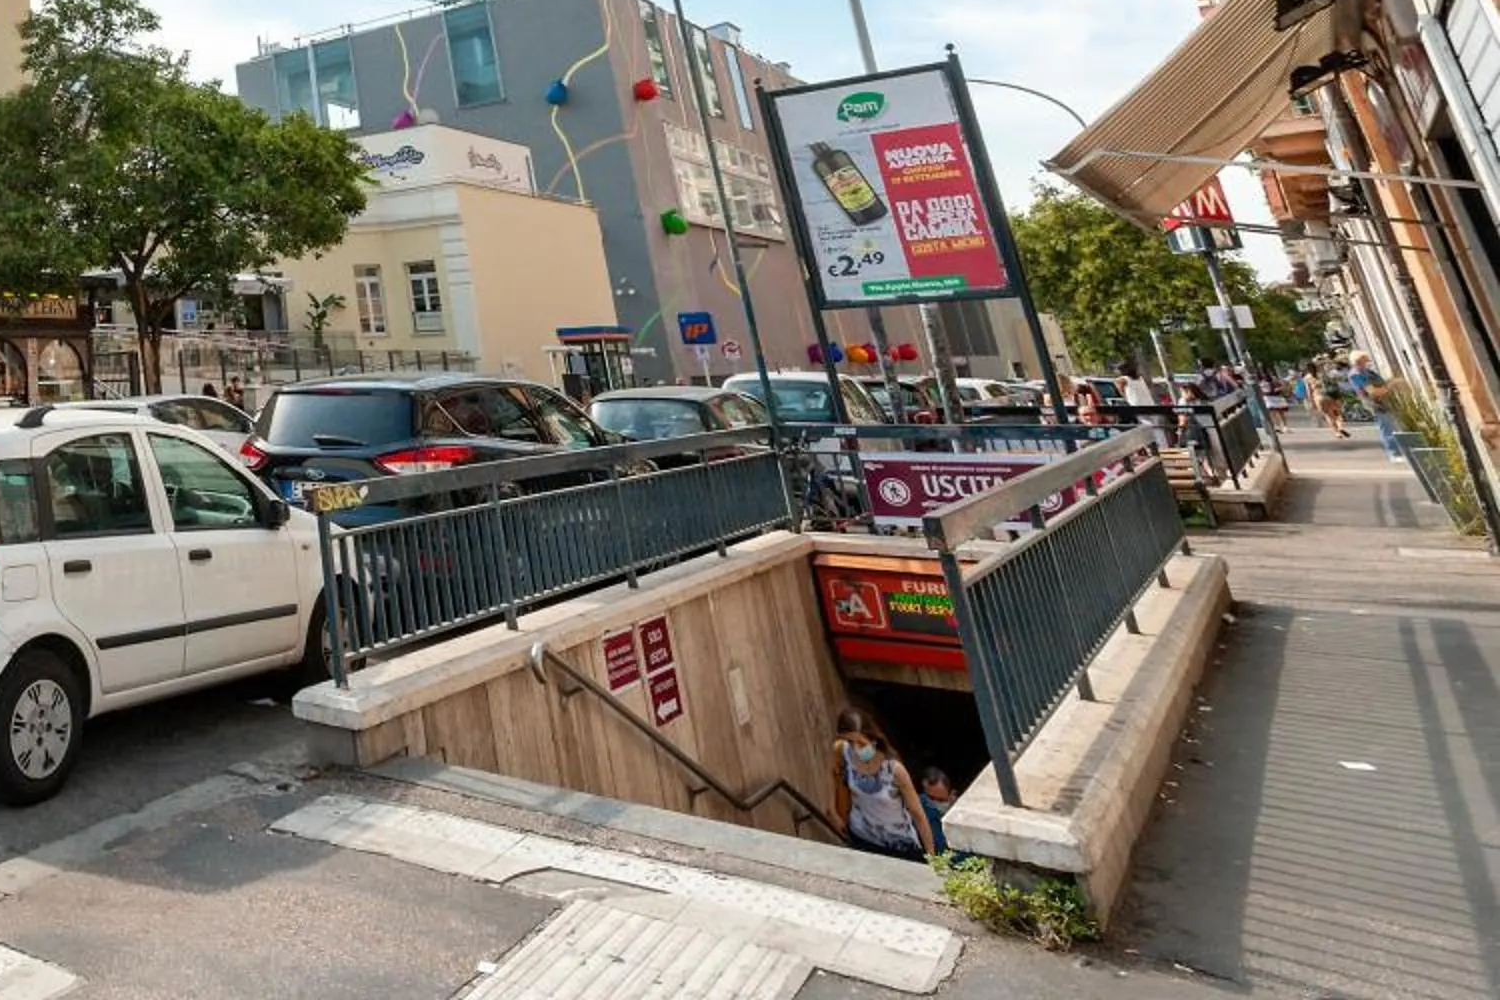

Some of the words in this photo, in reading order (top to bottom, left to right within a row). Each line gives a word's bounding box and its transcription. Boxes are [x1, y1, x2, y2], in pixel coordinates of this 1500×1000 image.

[843, 100, 879, 116] Pam
[884, 142, 955, 162] NUOVA
[895, 199, 924, 216] DA
[926, 193, 975, 212] OGGI
